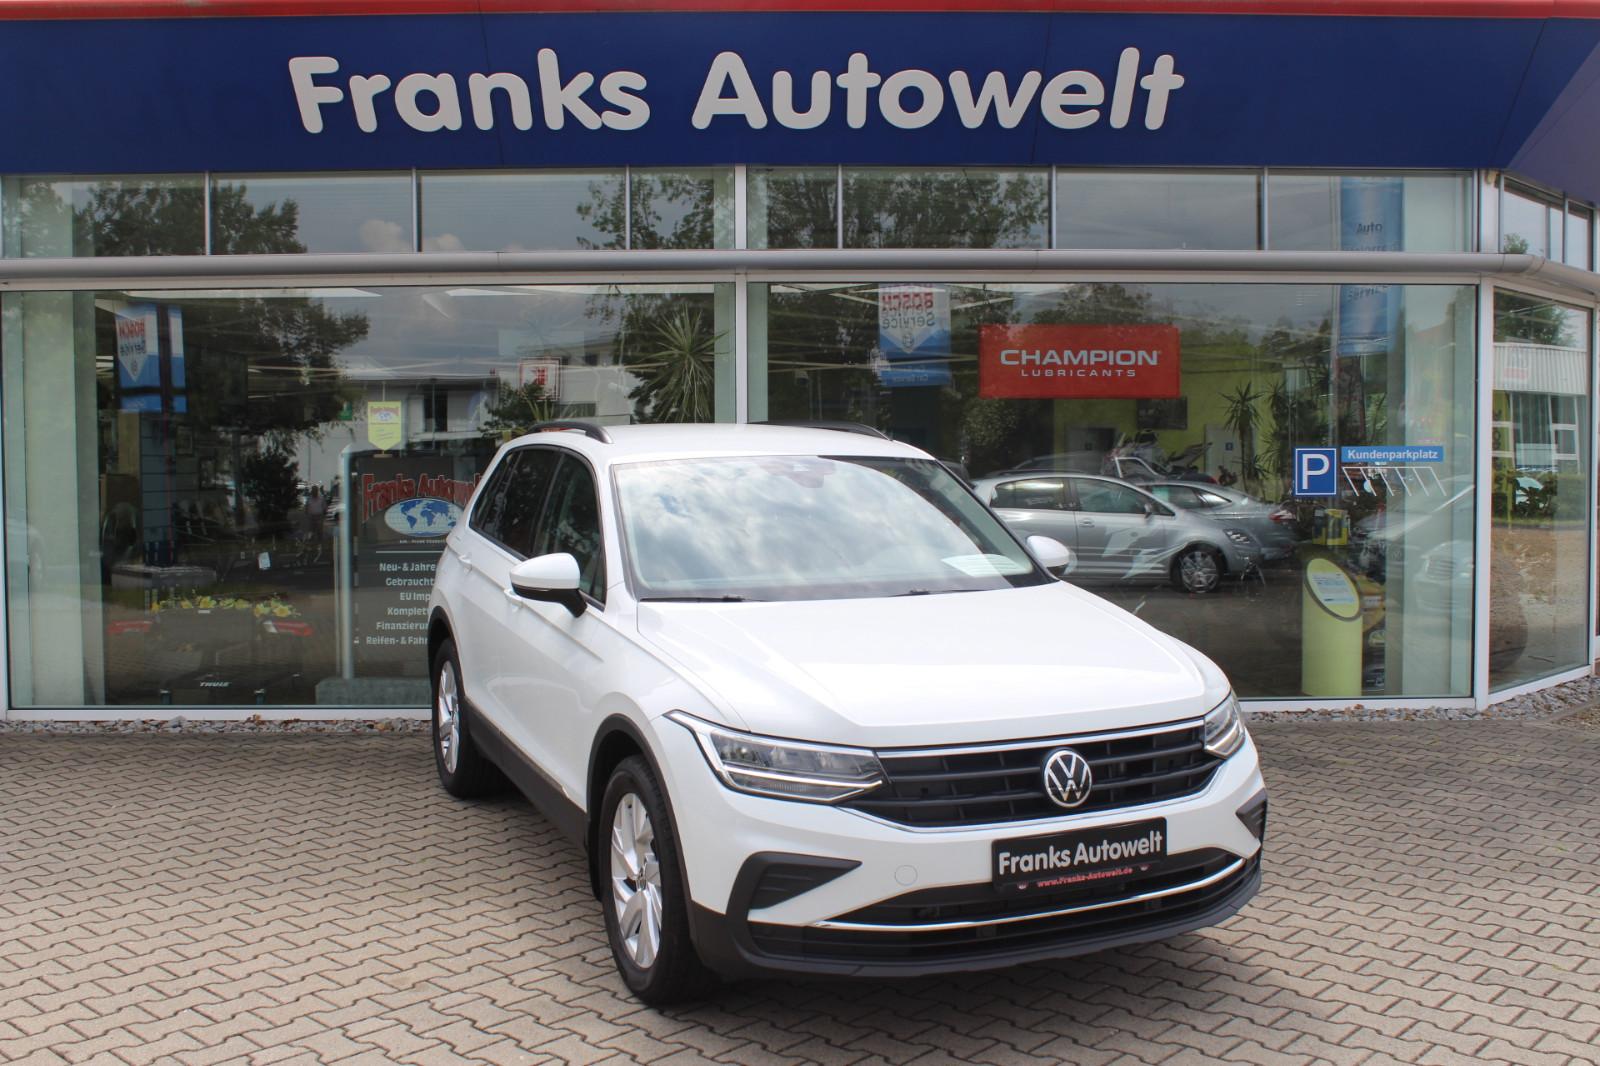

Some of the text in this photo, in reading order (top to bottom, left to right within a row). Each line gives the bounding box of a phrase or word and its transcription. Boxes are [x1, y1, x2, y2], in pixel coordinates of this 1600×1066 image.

[288, 46, 1185, 134] Franks Autowelt
[1000, 349, 1158, 366] CHAMPION
[1021, 369, 1136, 377] LUBRICANTS
[1347, 449, 1438, 461] Kundenparkplatz
[1302, 453, 1330, 490] P
[379, 563, 400, 572] Neu-
[402, 563, 409, 572] &
[400, 592, 412, 601] EU
[366, 636, 399, 645] Reifen-
[400, 636, 407, 645] &
[998, 830, 1163, 875] Franks Autowelt
